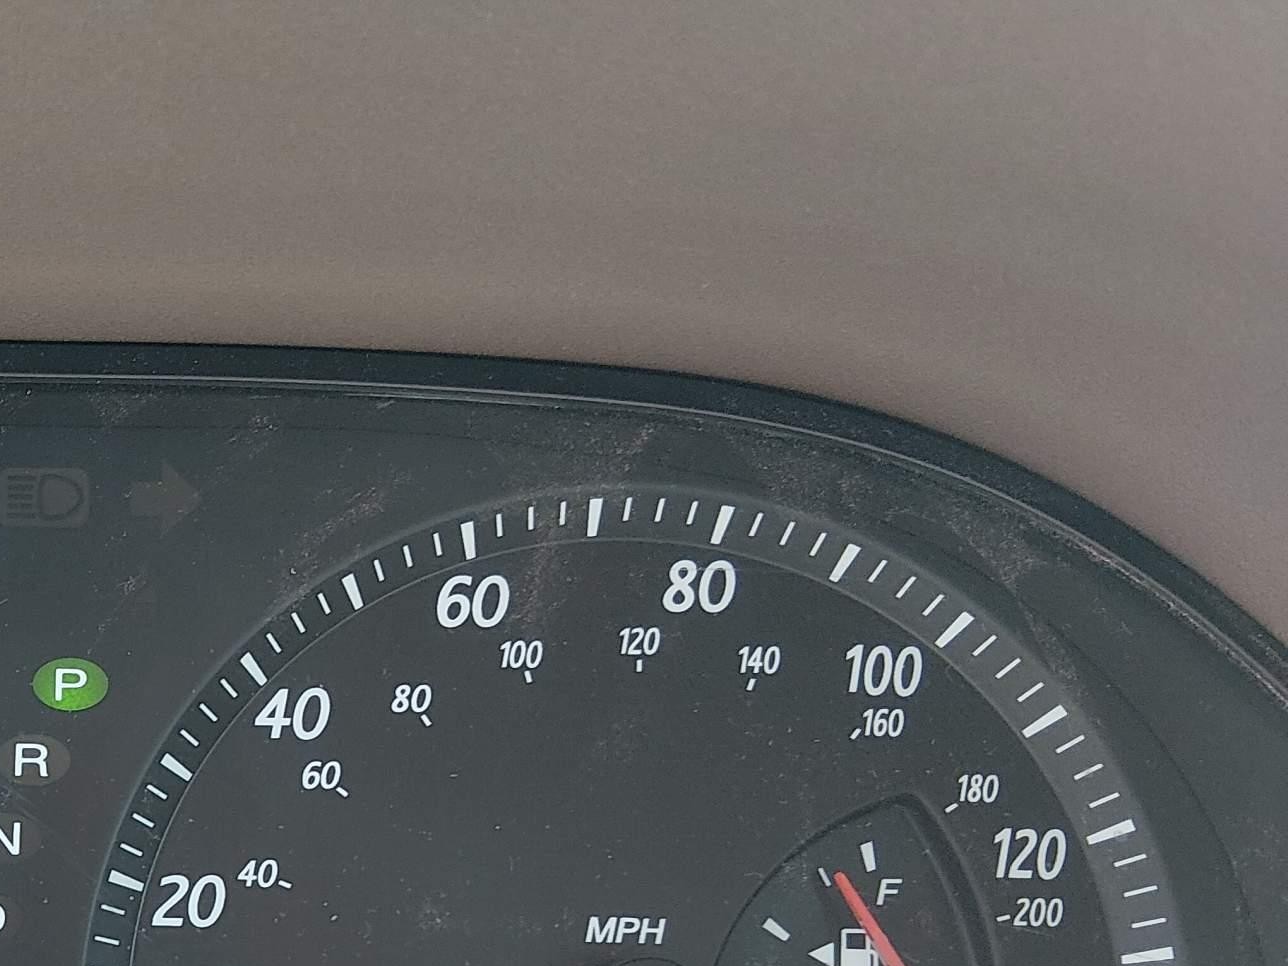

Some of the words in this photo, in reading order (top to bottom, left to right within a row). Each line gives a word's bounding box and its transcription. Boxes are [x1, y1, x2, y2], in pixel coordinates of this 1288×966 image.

[435, 574, 510, 628] 60
[661, 559, 736, 613] 80
[499, 640, 543, 670] 100
[619, 628, 660, 655] 120
[737, 646, 781, 675] 140
[844, 645, 922, 697] 100
[53, 668, 87, 700] P
[390, 684, 431, 714] 80
[254, 687, 331, 740] 40
[862, 709, 904, 737] 160
[14, 743, 49, 777] R
[301, 761, 341, 790] 60
[957, 774, 999, 803] 180
[993, 828, 1066, 880] 120
[237, 859, 278, 889] 40
[151, 874, 226, 927] 20
[877, 878, 902, 905] F
[1012, 898, 1063, 927] 200
[585, 917, 666, 944] MPH
